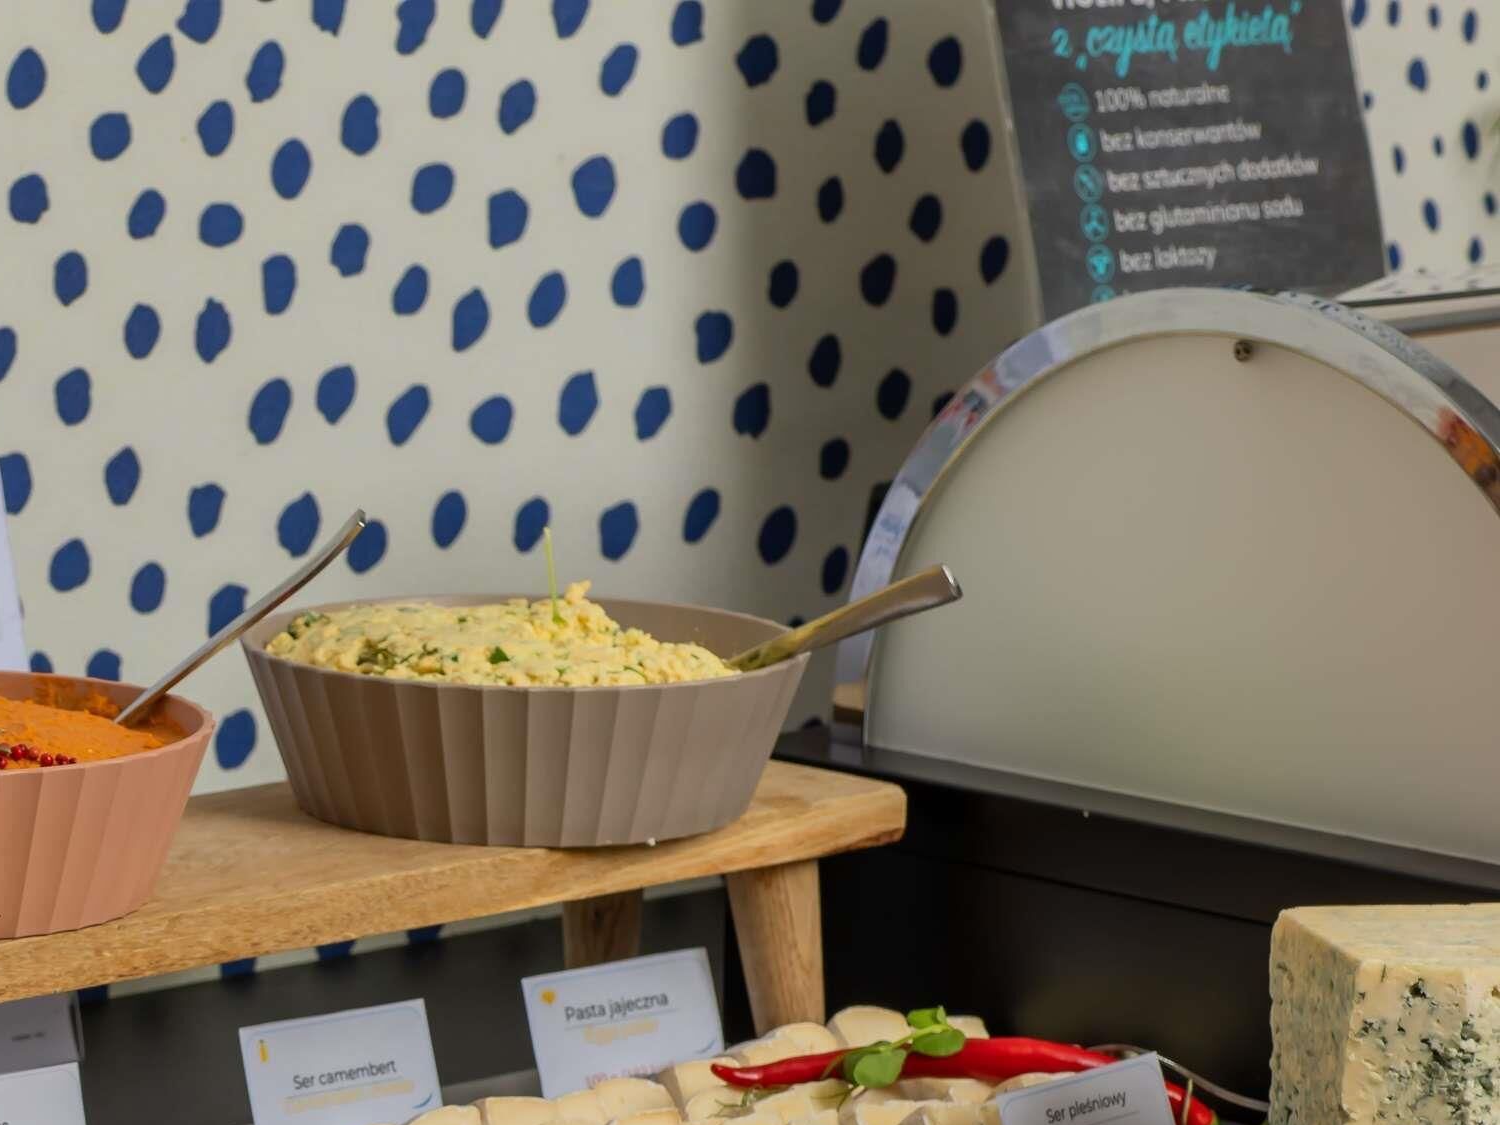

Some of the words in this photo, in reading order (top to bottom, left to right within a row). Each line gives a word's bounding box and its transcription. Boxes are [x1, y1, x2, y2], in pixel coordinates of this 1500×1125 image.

[1094, 86, 1148, 113] 100%
[1148, 81, 1231, 109] naturalne
[1100, 128, 1134, 153] bez
[1135, 119, 1262, 150] konserwantów
[1106, 169, 1141, 193] bez
[1142, 159, 1236, 190] sztucznych
[1236, 151, 1319, 182] dodatków
[1113, 210, 1148, 233] bez
[1260, 194, 1304, 219] sodu
[1119, 248, 1153, 273] bez
[564, 1004, 606, 1022] Pasta
[608, 992, 669, 1020] jajeczna
[292, 1072, 316, 1091] Ser
[318, 1059, 397, 1086] camembert
[1045, 1108, 1066, 1125] Ser
